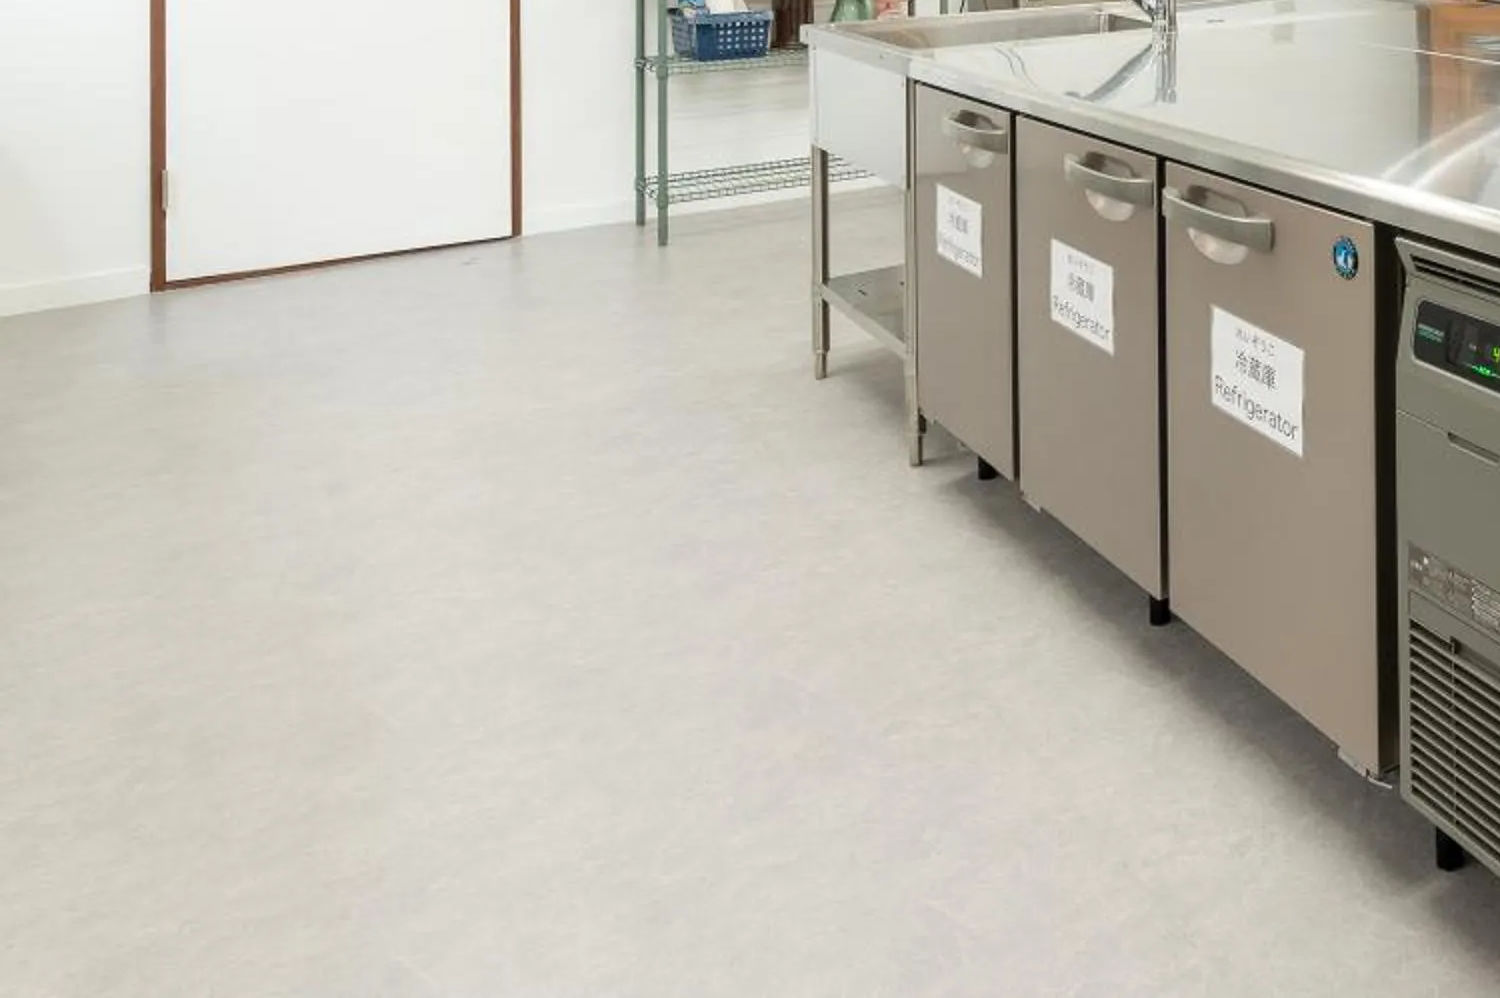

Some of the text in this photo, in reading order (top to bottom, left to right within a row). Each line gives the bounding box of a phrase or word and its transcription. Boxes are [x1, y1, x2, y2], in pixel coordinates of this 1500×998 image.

[1234, 349, 1278, 392] 冷蔵庫
[1214, 374, 1299, 440] Refrigerator
